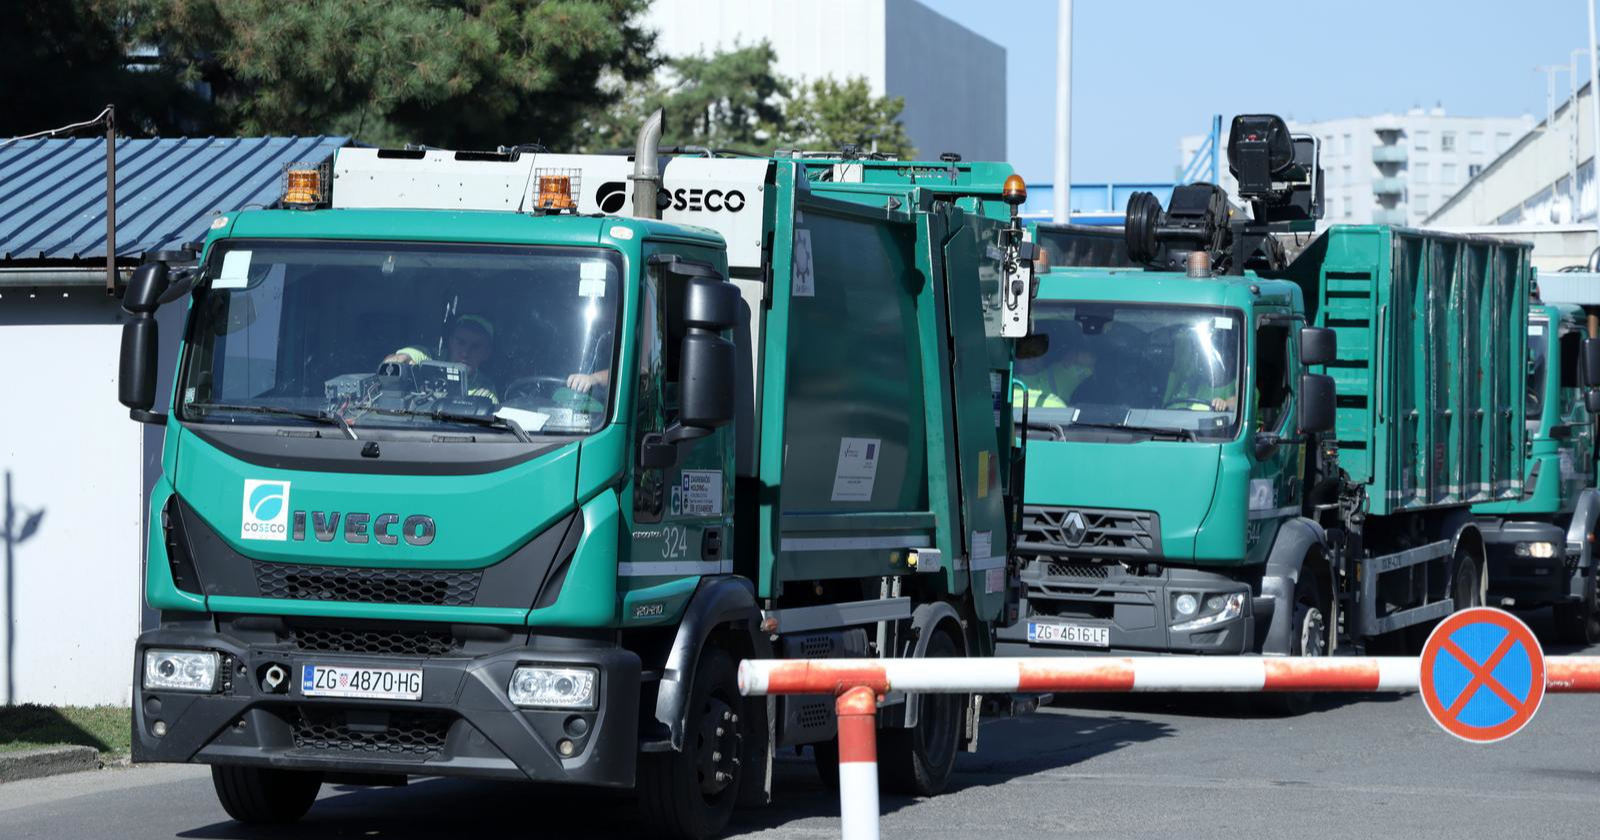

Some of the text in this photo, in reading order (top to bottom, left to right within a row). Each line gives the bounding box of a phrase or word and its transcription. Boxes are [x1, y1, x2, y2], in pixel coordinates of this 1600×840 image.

[631, 187, 746, 213] OSECO
[243, 522, 286, 533] COSECO
[293, 511, 436, 545] IVECO
[661, 526, 688, 559] 324
[1037, 625, 1052, 639] ZG
[315, 669, 337, 689] ZG
